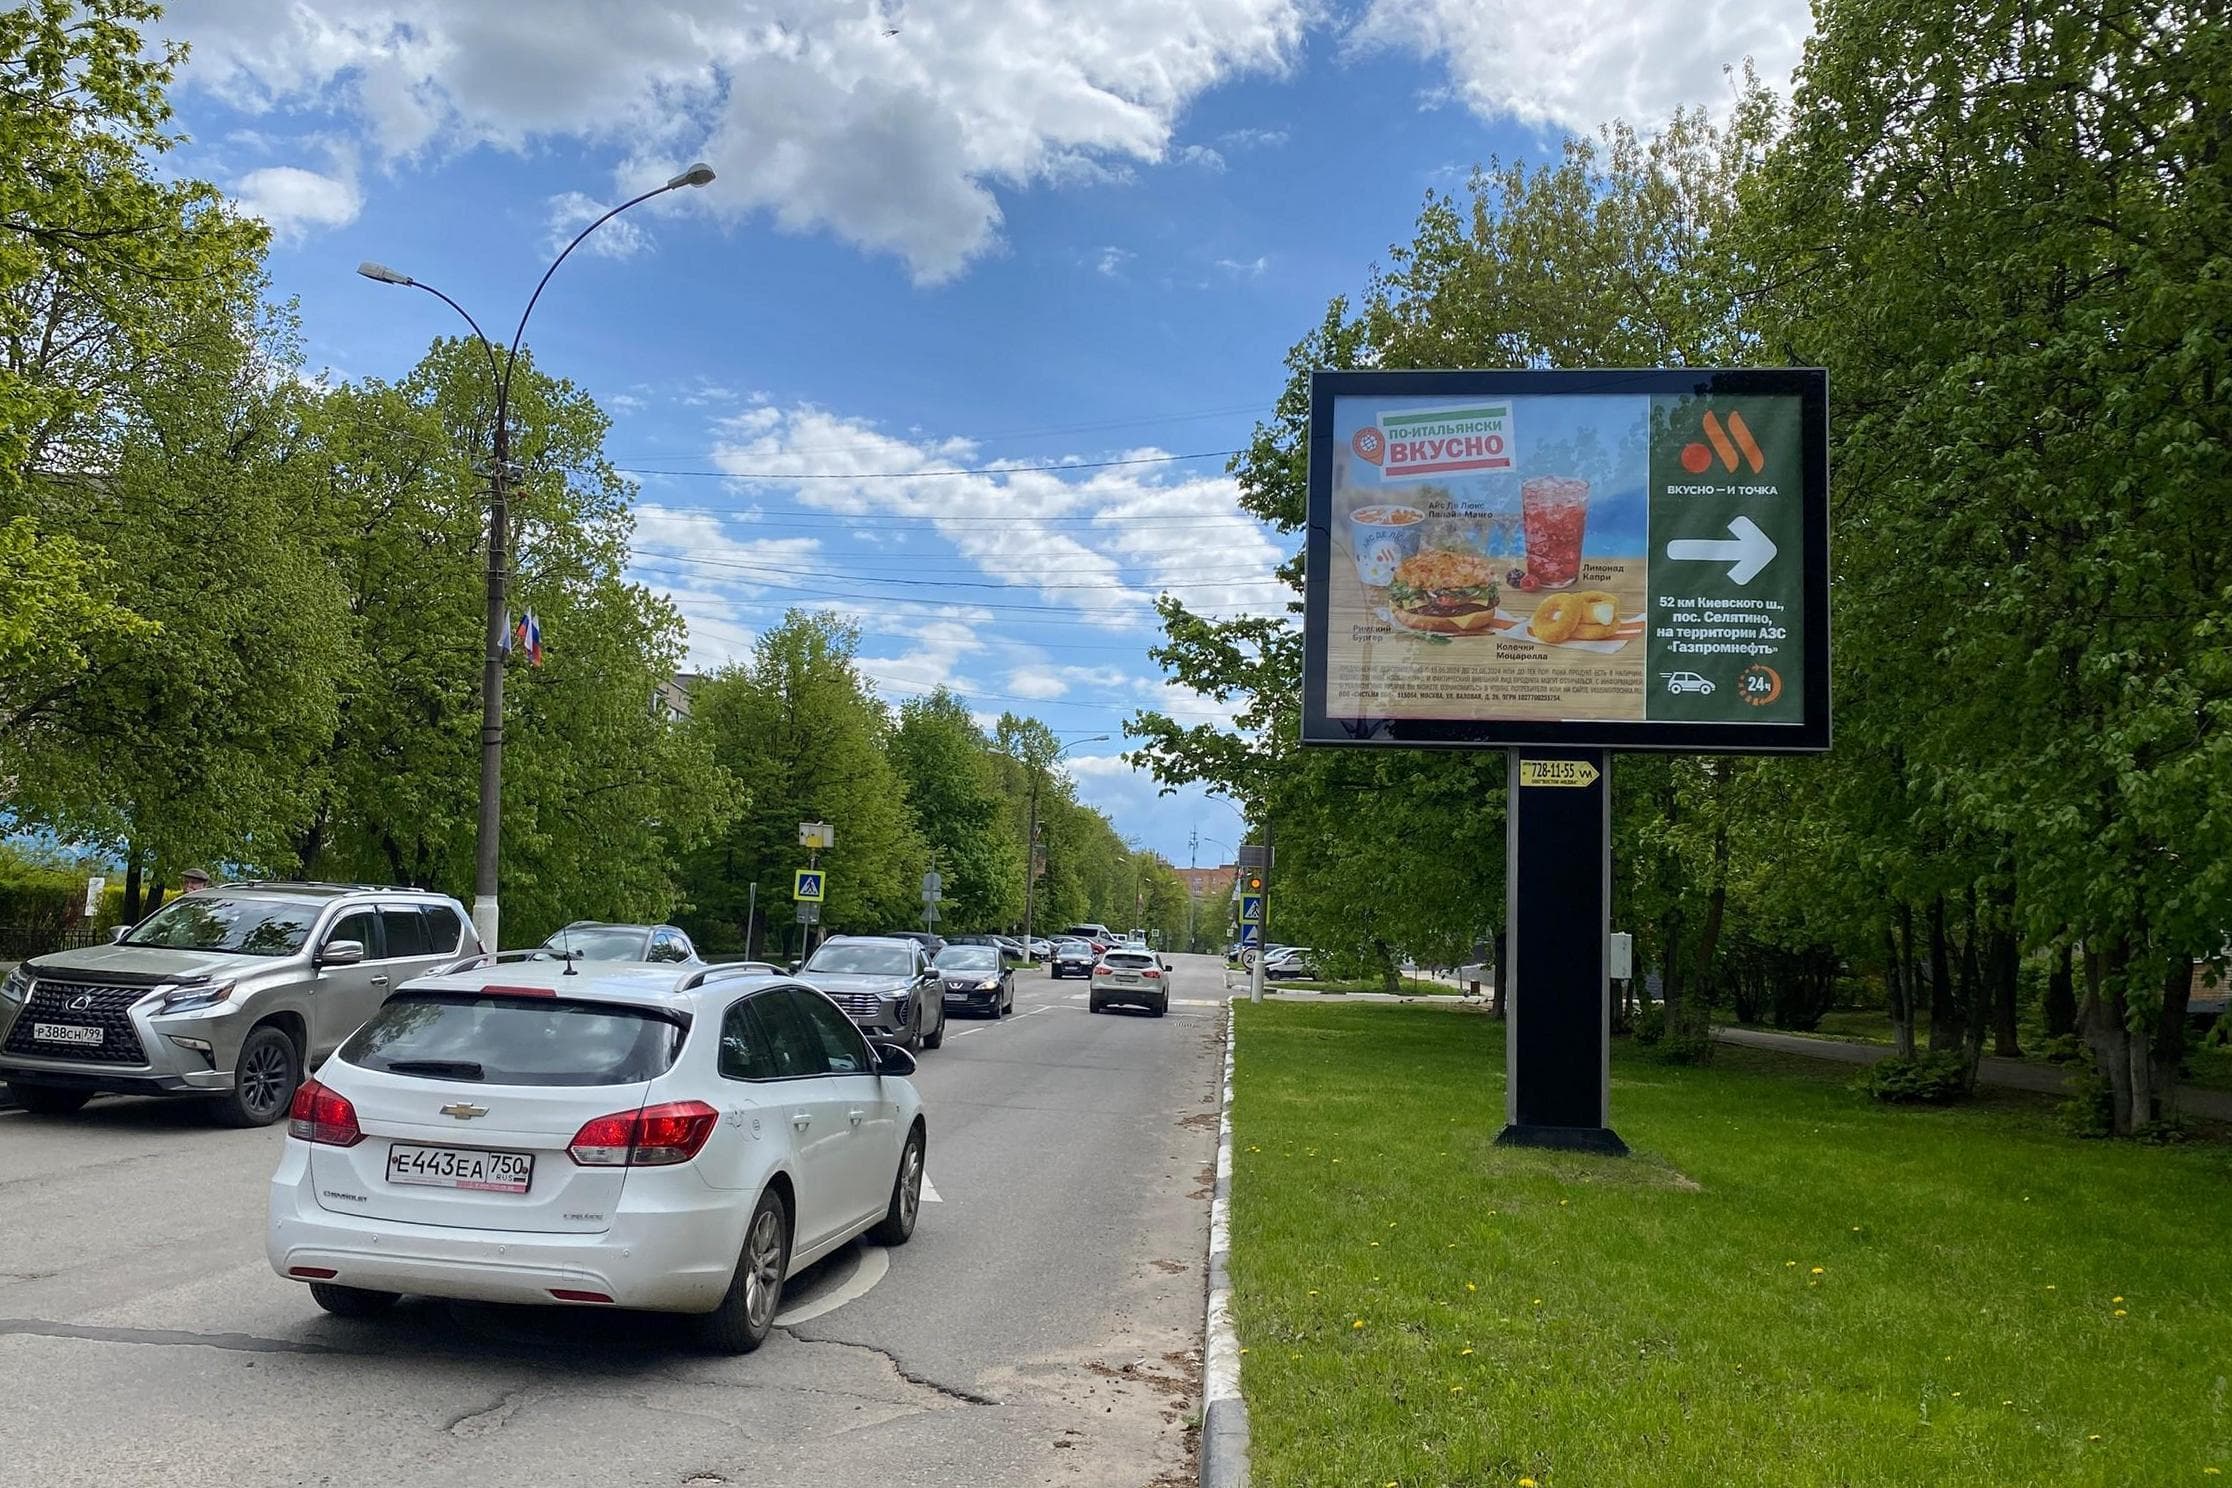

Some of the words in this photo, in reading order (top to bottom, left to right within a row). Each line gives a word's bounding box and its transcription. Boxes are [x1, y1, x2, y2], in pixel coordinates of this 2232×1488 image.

[1389, 420, 1502, 439] ПО-ИТАЛЬЯНСКИ
[1390, 435, 1504, 463] ВКУСНО
[1667, 485, 1714, 495] ВКУСНО
[1727, 486, 1736, 495] И
[1738, 486, 1778, 495] ТОЧКА
[1583, 564, 1624, 572] Лимонад
[1583, 573, 1611, 582] Капри
[1660, 597, 1675, 608] 52
[1677, 599, 1695, 608] км
[1698, 597, 1764, 609] Киевского
[1766, 601, 1785, 612] ш.,
[1673, 613, 1701, 623] пос.
[1704, 611, 1773, 626] Селятино,
[1656, 628, 1674, 638] на
[1676, 628, 1757, 640] территории
[1759, 628, 1787, 639] АЗС
[1496, 643, 1535, 651] Колечки
[1667, 641, 1778, 656] «Газпромнефть»
[1496, 652, 1549, 661] Моцарелла
[1747, 676, 1772, 692] 24ч
[1532, 762, 1575, 778] 728-11-55
[83, 1028, 101, 1038] 799
[491, 1154, 524, 1174] 750
